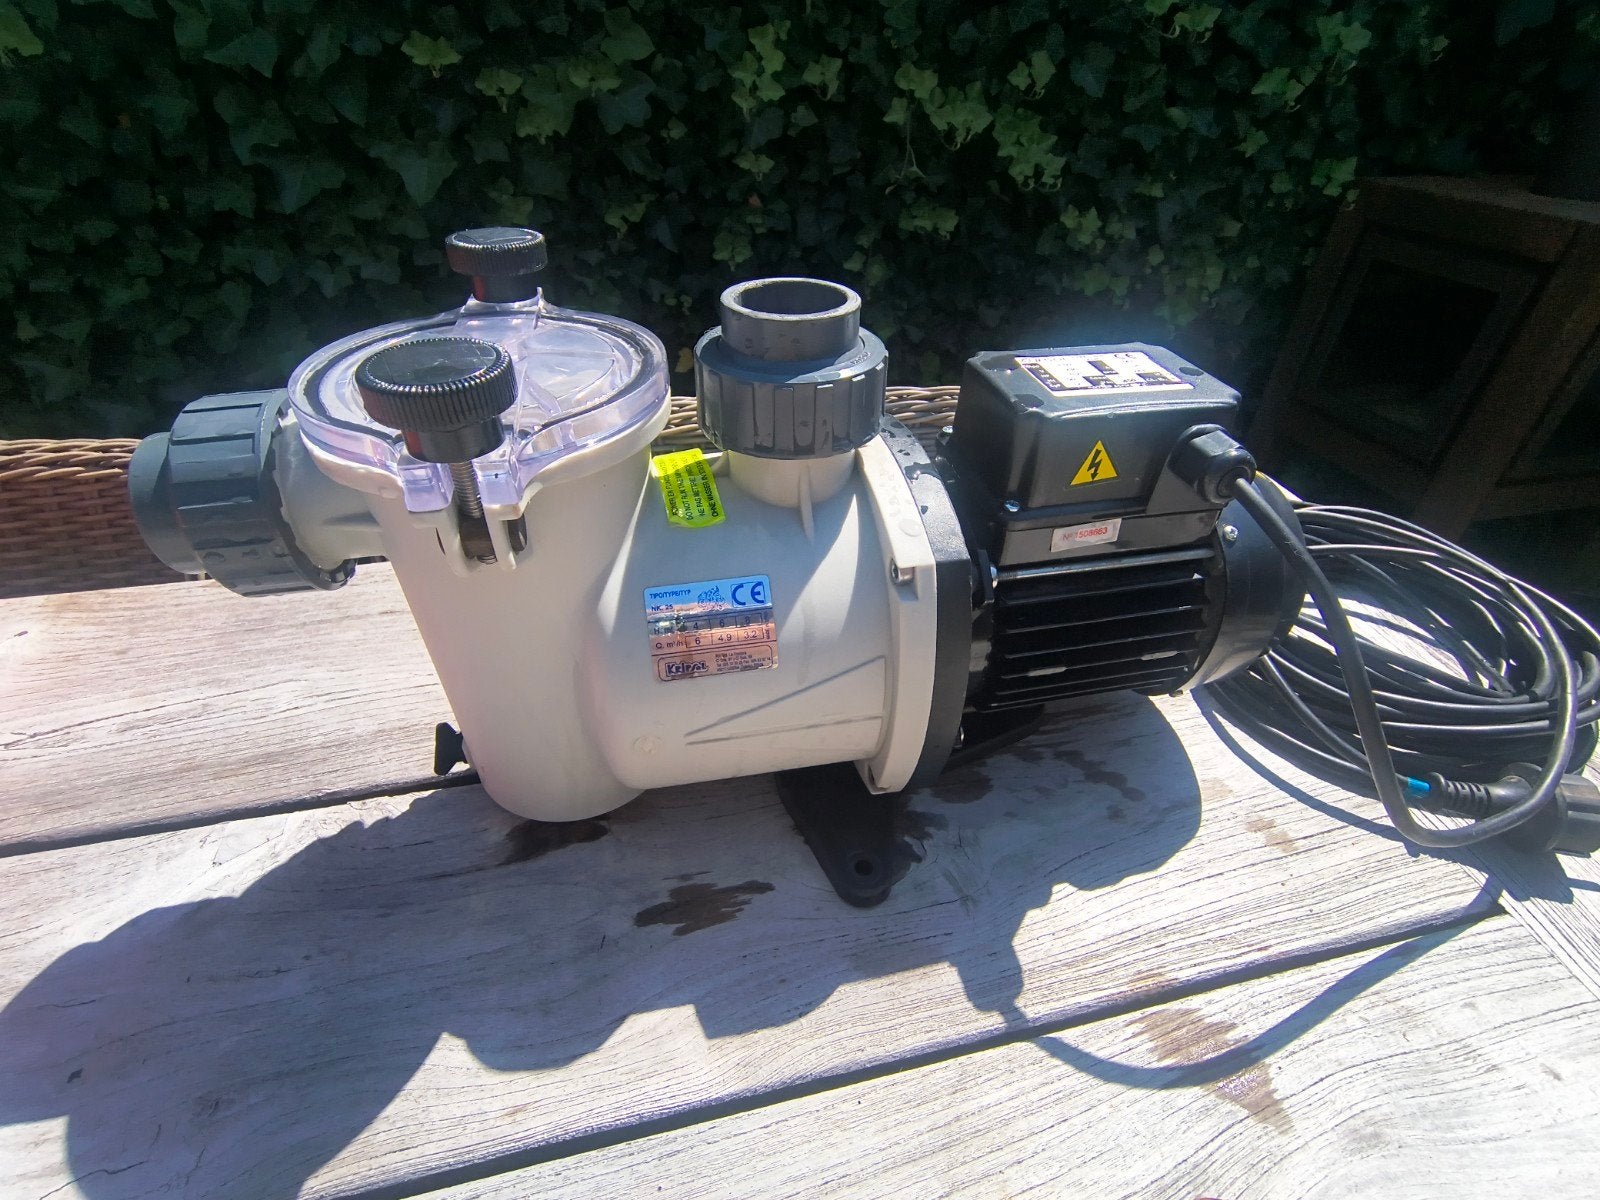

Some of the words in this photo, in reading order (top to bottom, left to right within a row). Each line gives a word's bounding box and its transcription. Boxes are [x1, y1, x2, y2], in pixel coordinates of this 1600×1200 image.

[731, 581, 765, 606] CE
[694, 637, 701, 645] 6
[718, 633, 732, 642] 4.9
[743, 630, 758, 640] 3.2
